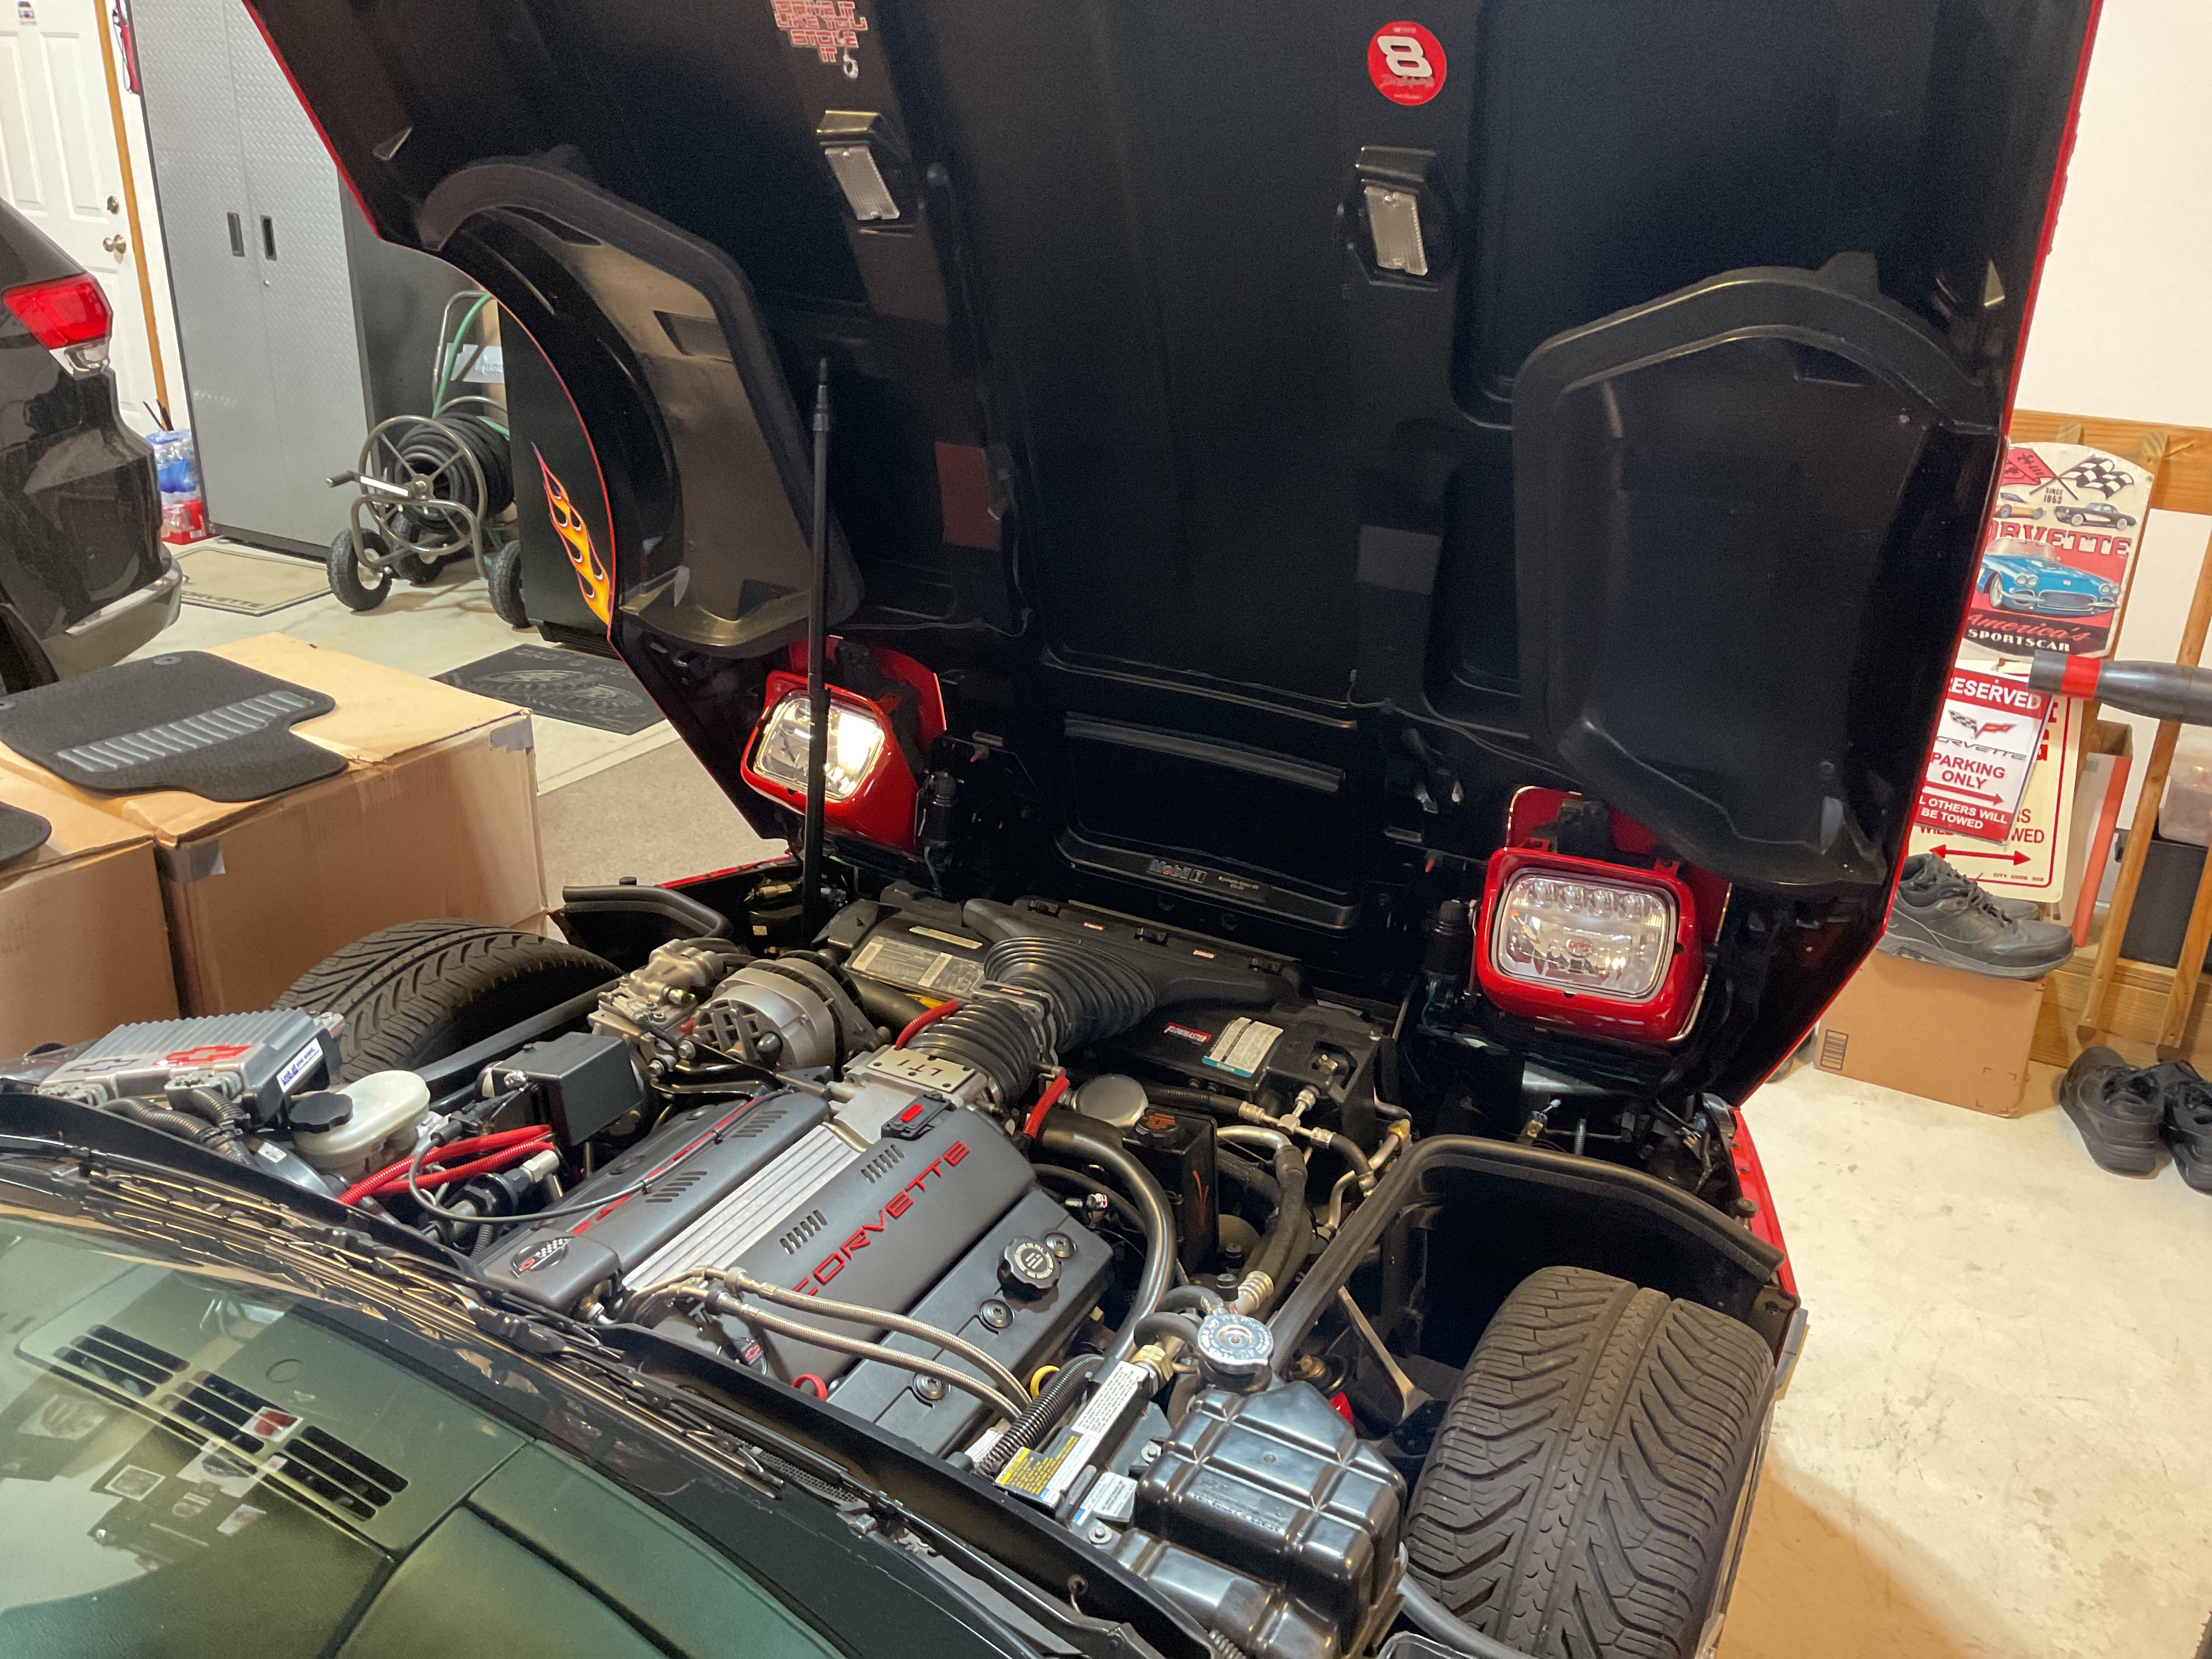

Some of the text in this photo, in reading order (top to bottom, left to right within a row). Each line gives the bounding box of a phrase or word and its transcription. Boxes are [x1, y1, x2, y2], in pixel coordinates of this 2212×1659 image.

[774, 13, 820, 29] LIKE
[790, 29, 859, 48] STOLE
[819, 46, 838, 63] IT
[1378, 36, 1433, 77] 8
[2045, 487, 2063, 495] SINCE
[1986, 519, 2133, 557] ORVETTE
[181, 590, 265, 608] ORVETTE
[1967, 614, 2091, 641] America's
[1967, 629, 2070, 652] SPORTSCAR
[1948, 677, 2042, 710] ESERVED
[1936, 736, 2027, 761] ORVETTE
[1931, 752, 2006, 779] PARKING
[1942, 770, 1988, 790] ONLY
[1921, 807, 1984, 830] BE TOWED
[1928, 798, 1977, 816] OTHERS
[1979, 809, 2007, 825] WILL
[2011, 827, 2045, 844] WED
[896, 1059, 944, 1076] LT1
